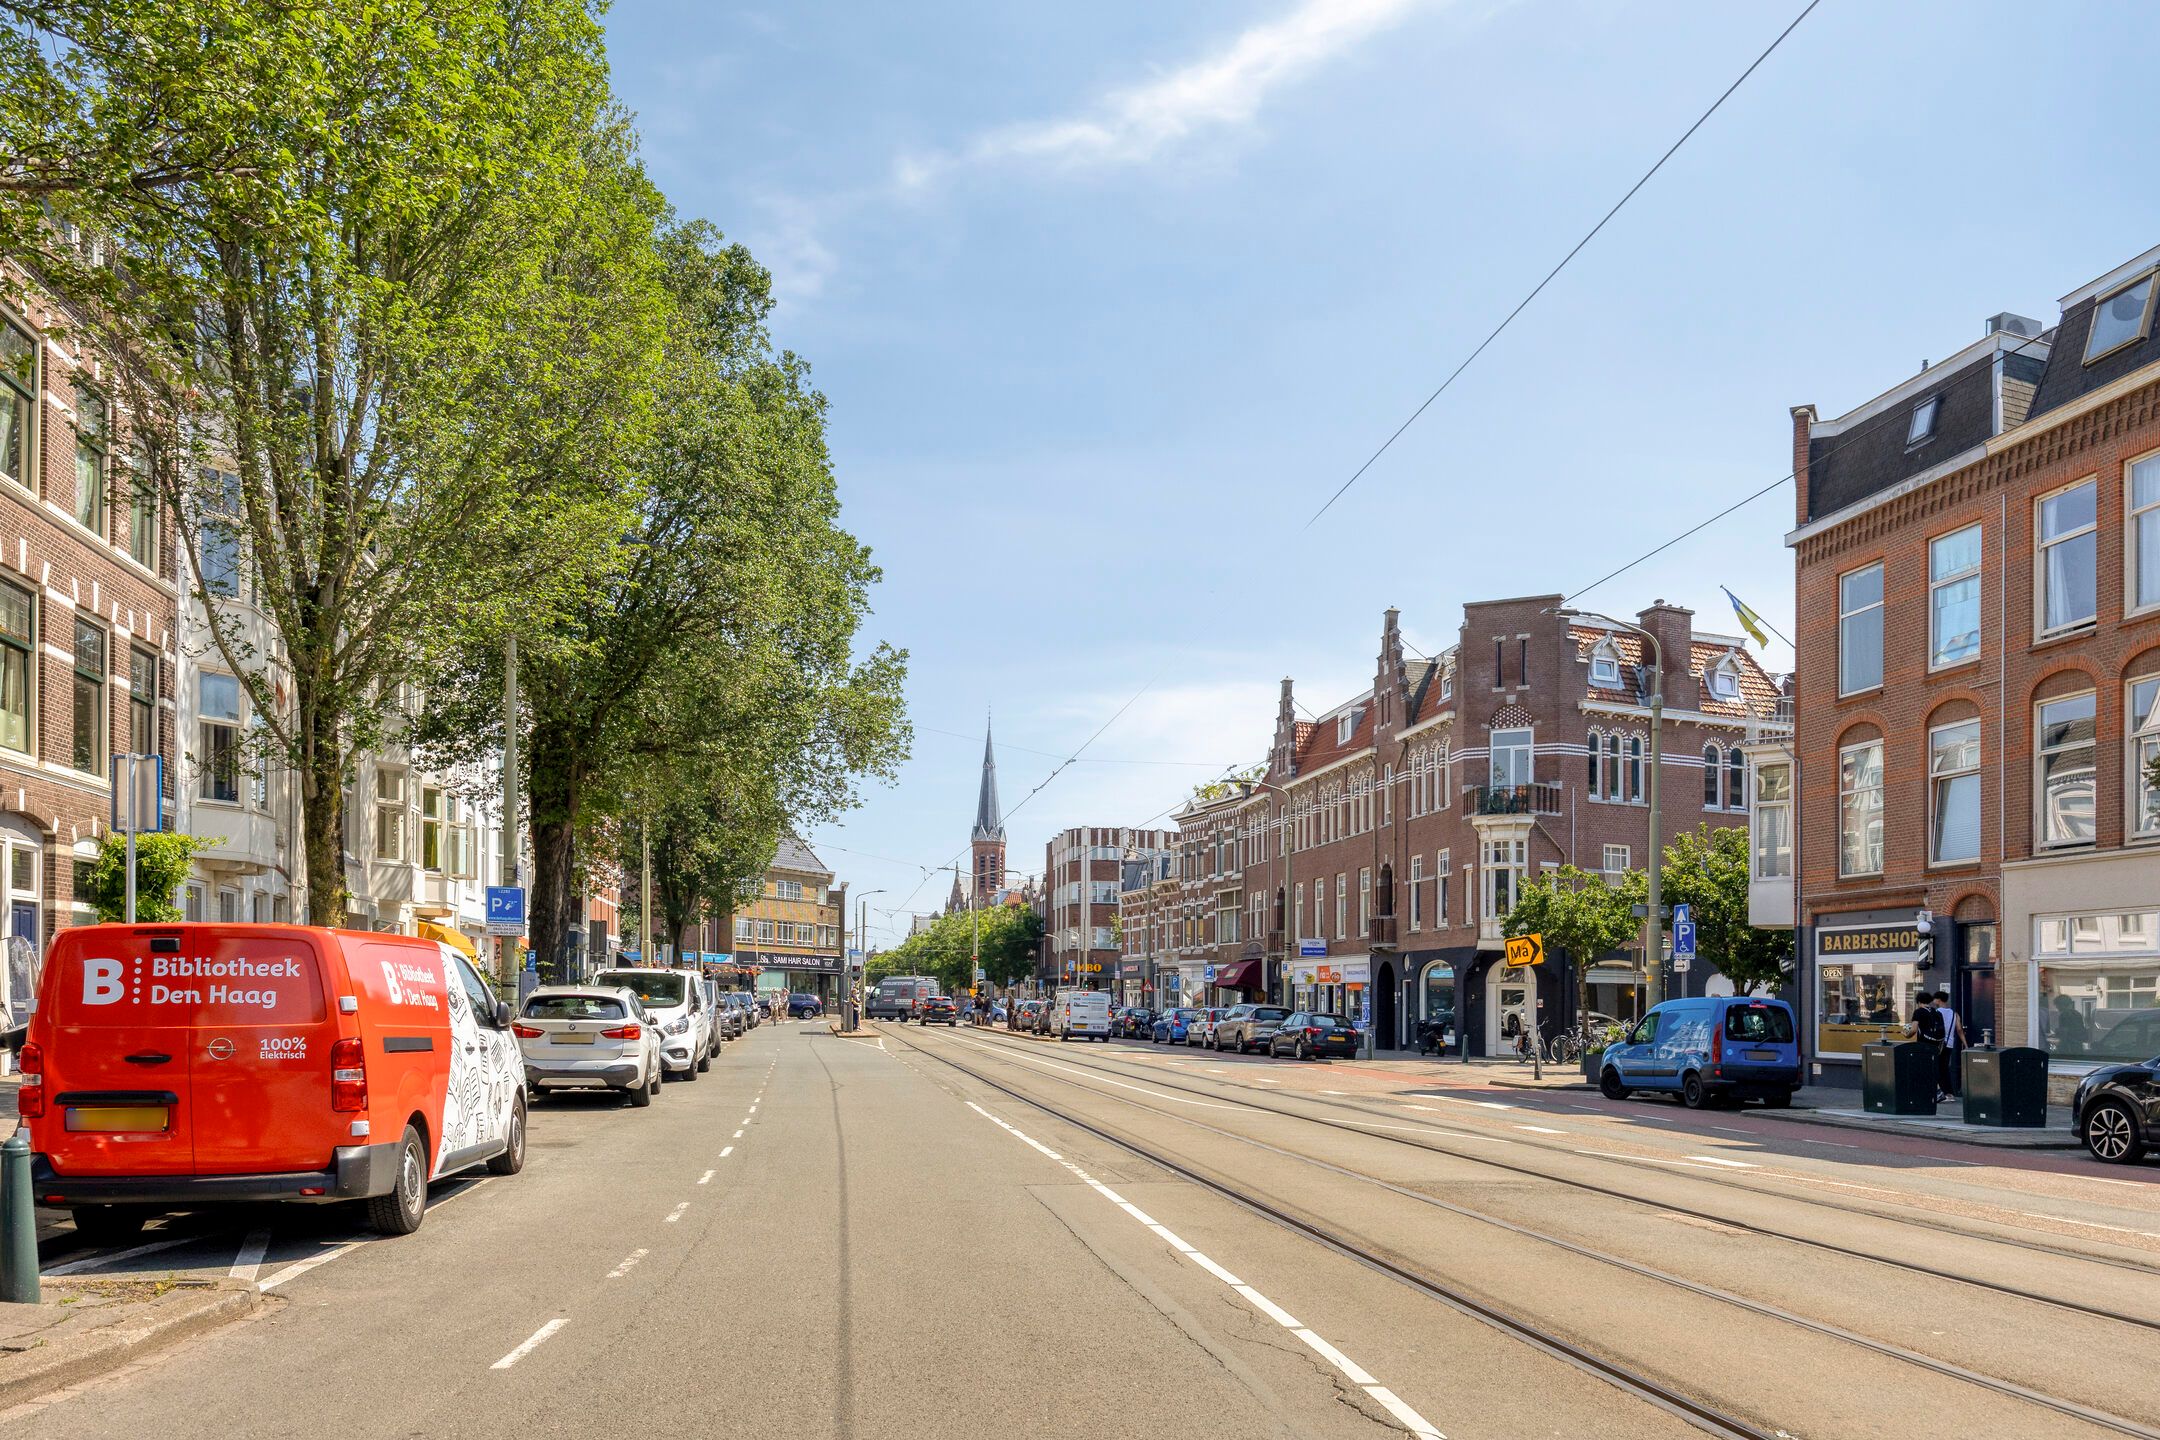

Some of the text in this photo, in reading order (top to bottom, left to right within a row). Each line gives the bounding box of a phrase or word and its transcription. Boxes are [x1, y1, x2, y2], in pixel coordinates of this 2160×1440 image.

[491, 897, 503, 912] P
[1678, 924, 1691, 941] P
[1824, 931, 1918, 951] BARBERSHOP
[528, 952, 536, 961] P
[773, 956, 787, 964] SAMI
[787, 956, 802, 965] HAIR
[801, 958, 820, 966] SALON
[152, 957, 300, 977] Bibliotheek
[399, 963, 436, 984] Bibliotheek
[1823, 969, 1842, 977] OPEN
[82, 958, 125, 1005] B
[380, 960, 403, 1005] B
[151, 985, 277, 1009] Den Haag
[406, 988, 439, 1011] Den Haag
[260, 1037, 307, 1051] 100%
[260, 1051, 306, 1060] Elektrisch
